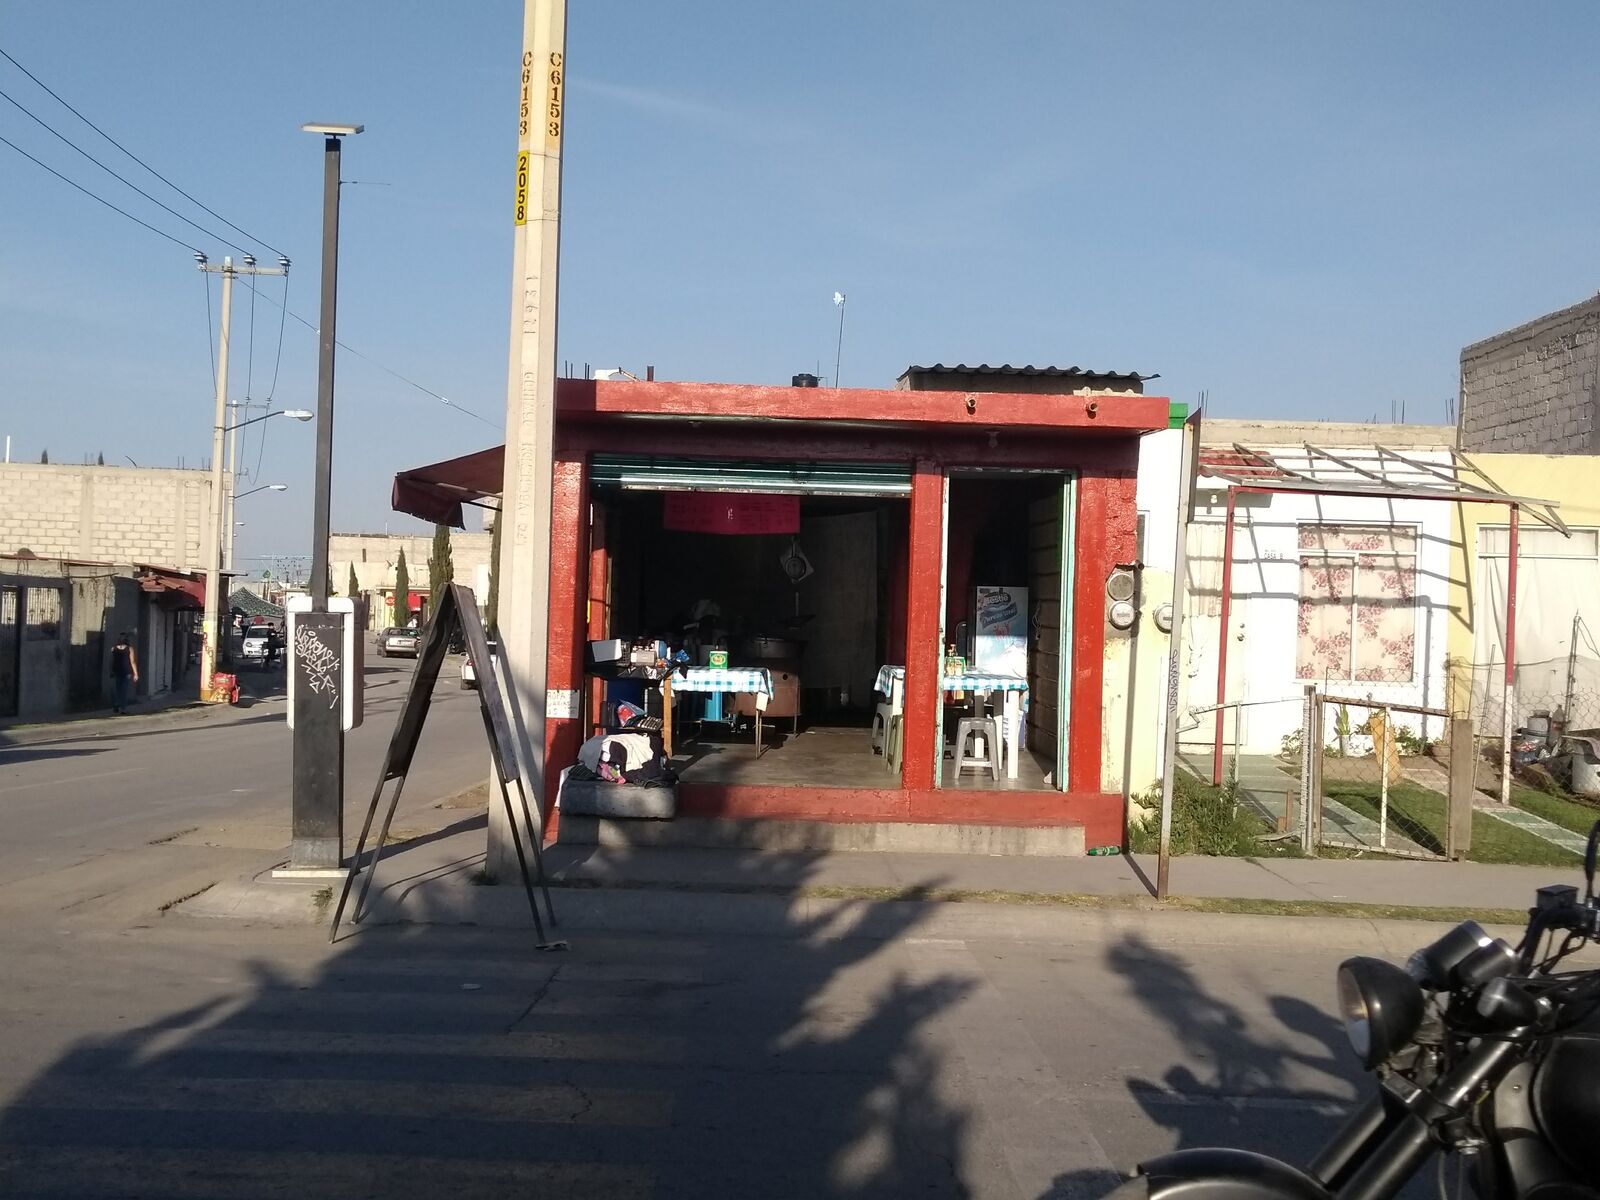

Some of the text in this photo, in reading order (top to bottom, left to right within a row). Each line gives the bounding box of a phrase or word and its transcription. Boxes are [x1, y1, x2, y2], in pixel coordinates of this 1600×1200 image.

[520, 51, 532, 136] C6153
[549, 51, 562, 137] C6153
[516, 155, 527, 221] 2058
